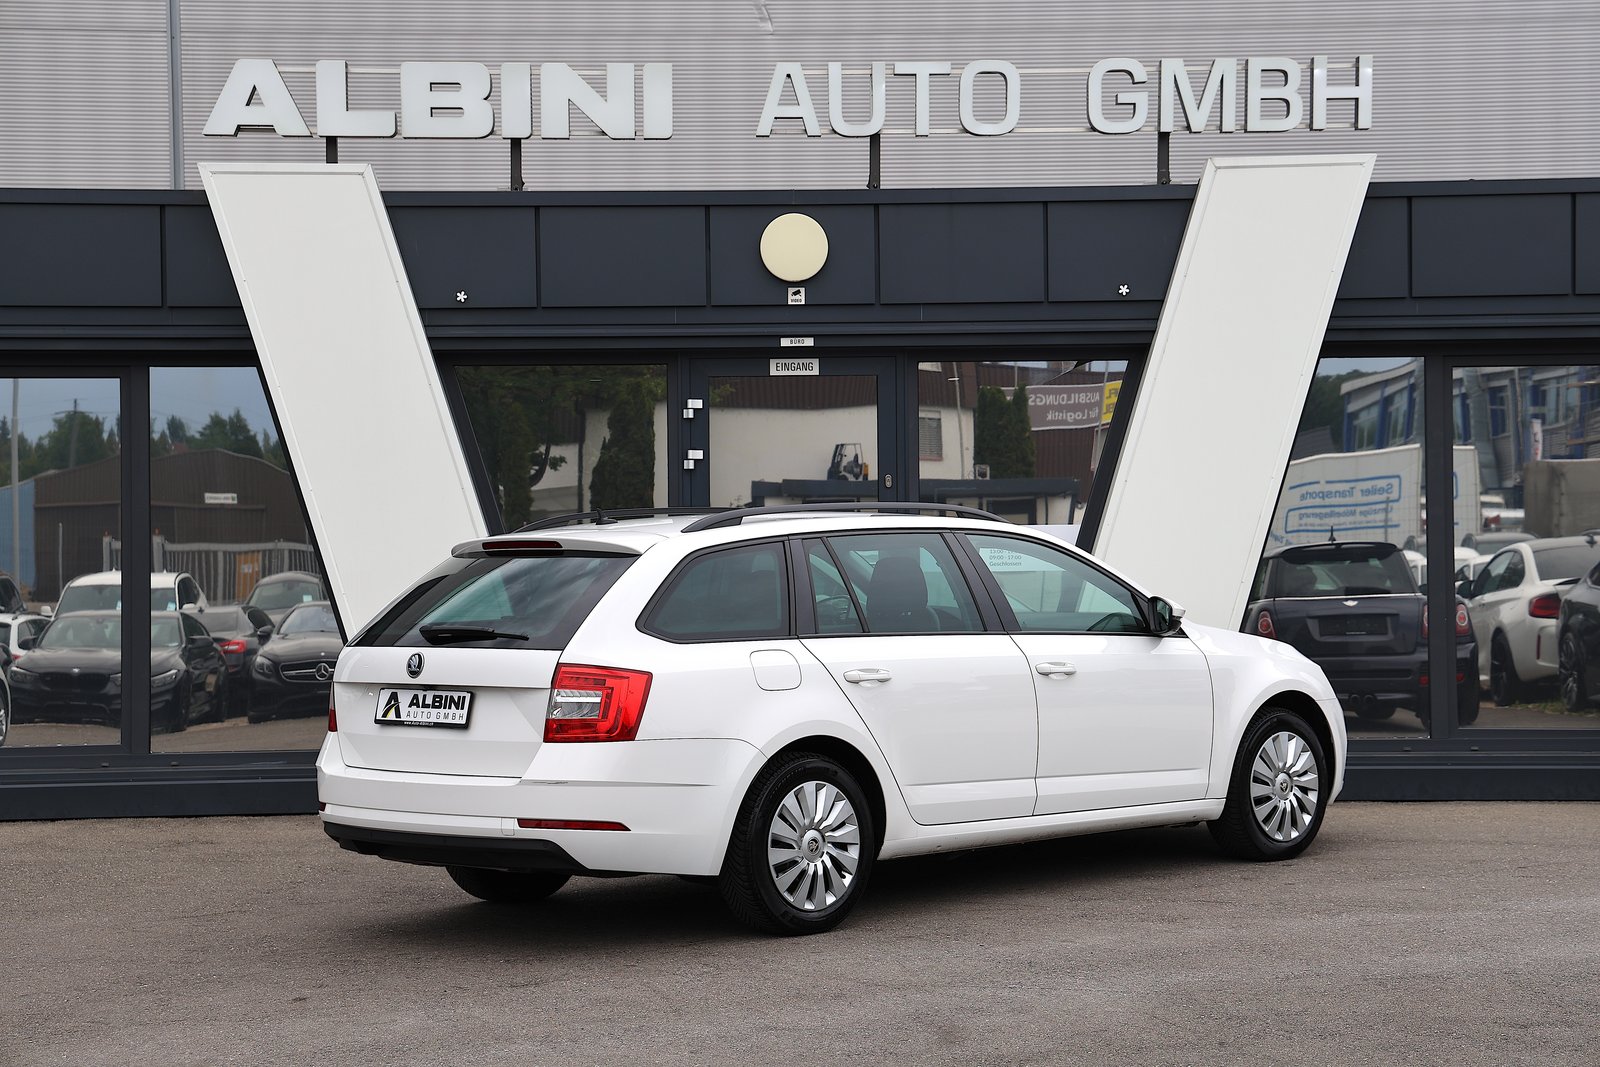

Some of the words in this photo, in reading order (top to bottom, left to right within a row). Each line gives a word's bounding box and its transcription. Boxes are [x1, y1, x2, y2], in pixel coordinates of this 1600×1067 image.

[203, 58, 673, 140] ALBINI
[755, 59, 1021, 138] AUTO
[1086, 55, 1373, 135] GMBH
[775, 362, 814, 372] EINGANG
[408, 694, 467, 711] ALBINI
[406, 710, 431, 720] AUTO
[436, 711, 464, 721] GMBH
